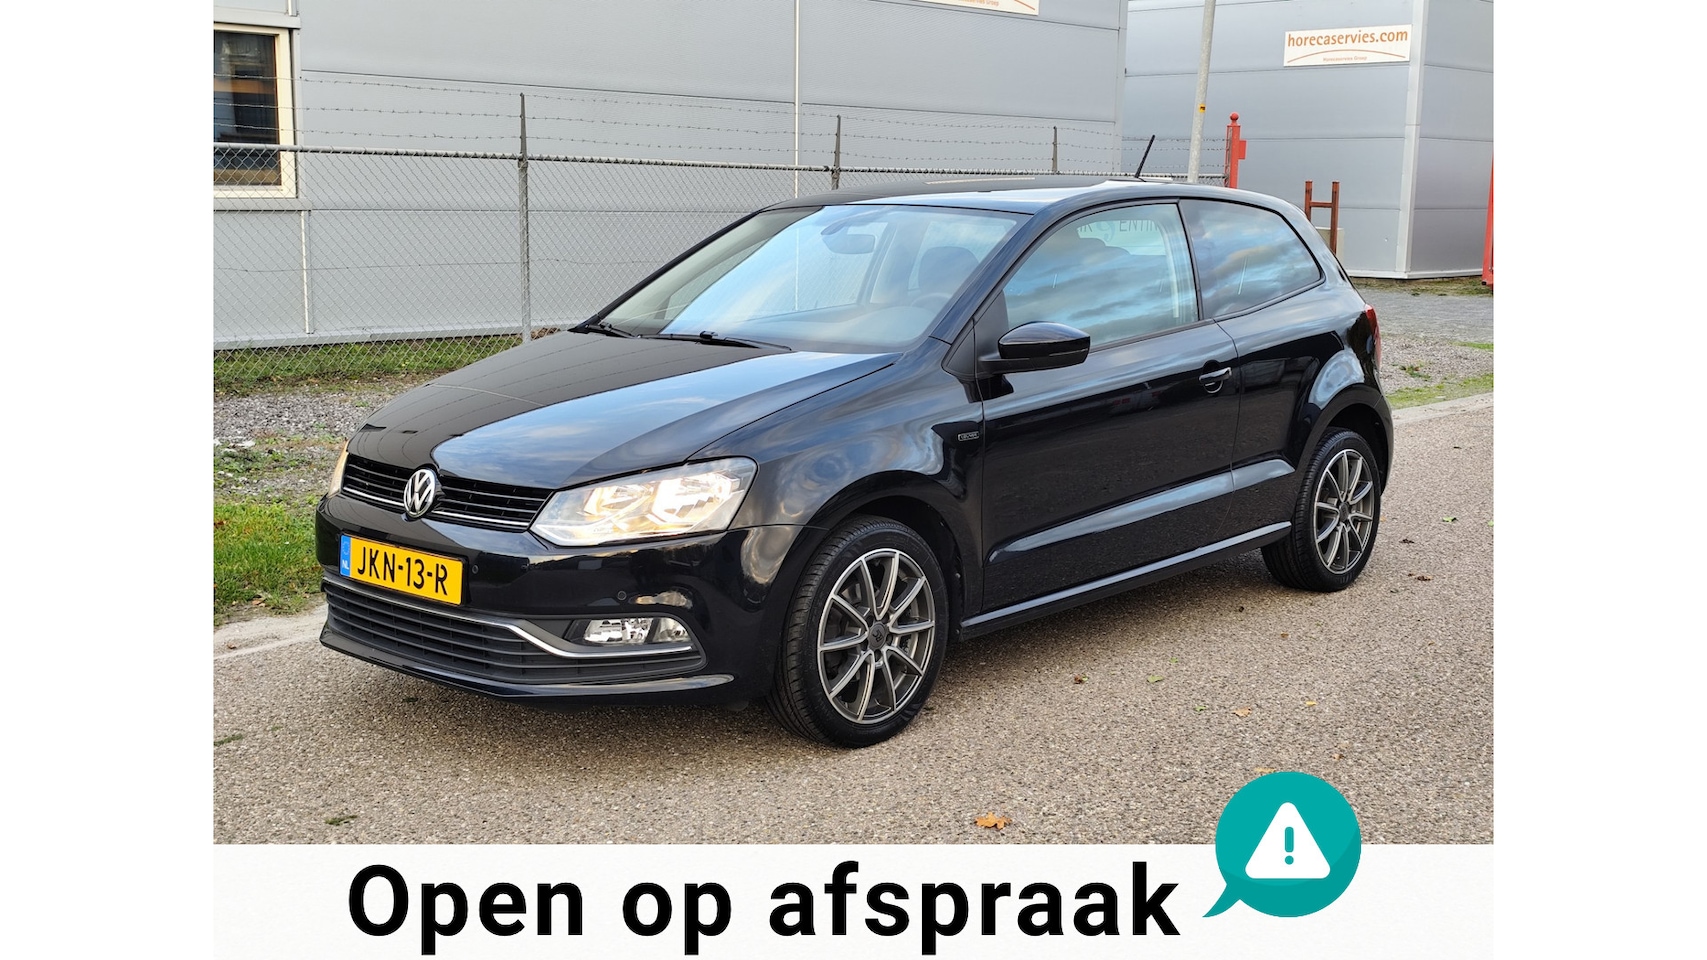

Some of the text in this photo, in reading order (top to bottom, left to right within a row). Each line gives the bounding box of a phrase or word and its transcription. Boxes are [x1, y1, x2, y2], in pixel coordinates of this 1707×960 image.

[1287, 29, 1408, 47] horecaservies.com
[342, 559, 350, 570] NL
[357, 546, 448, 596] JKN-13-R
